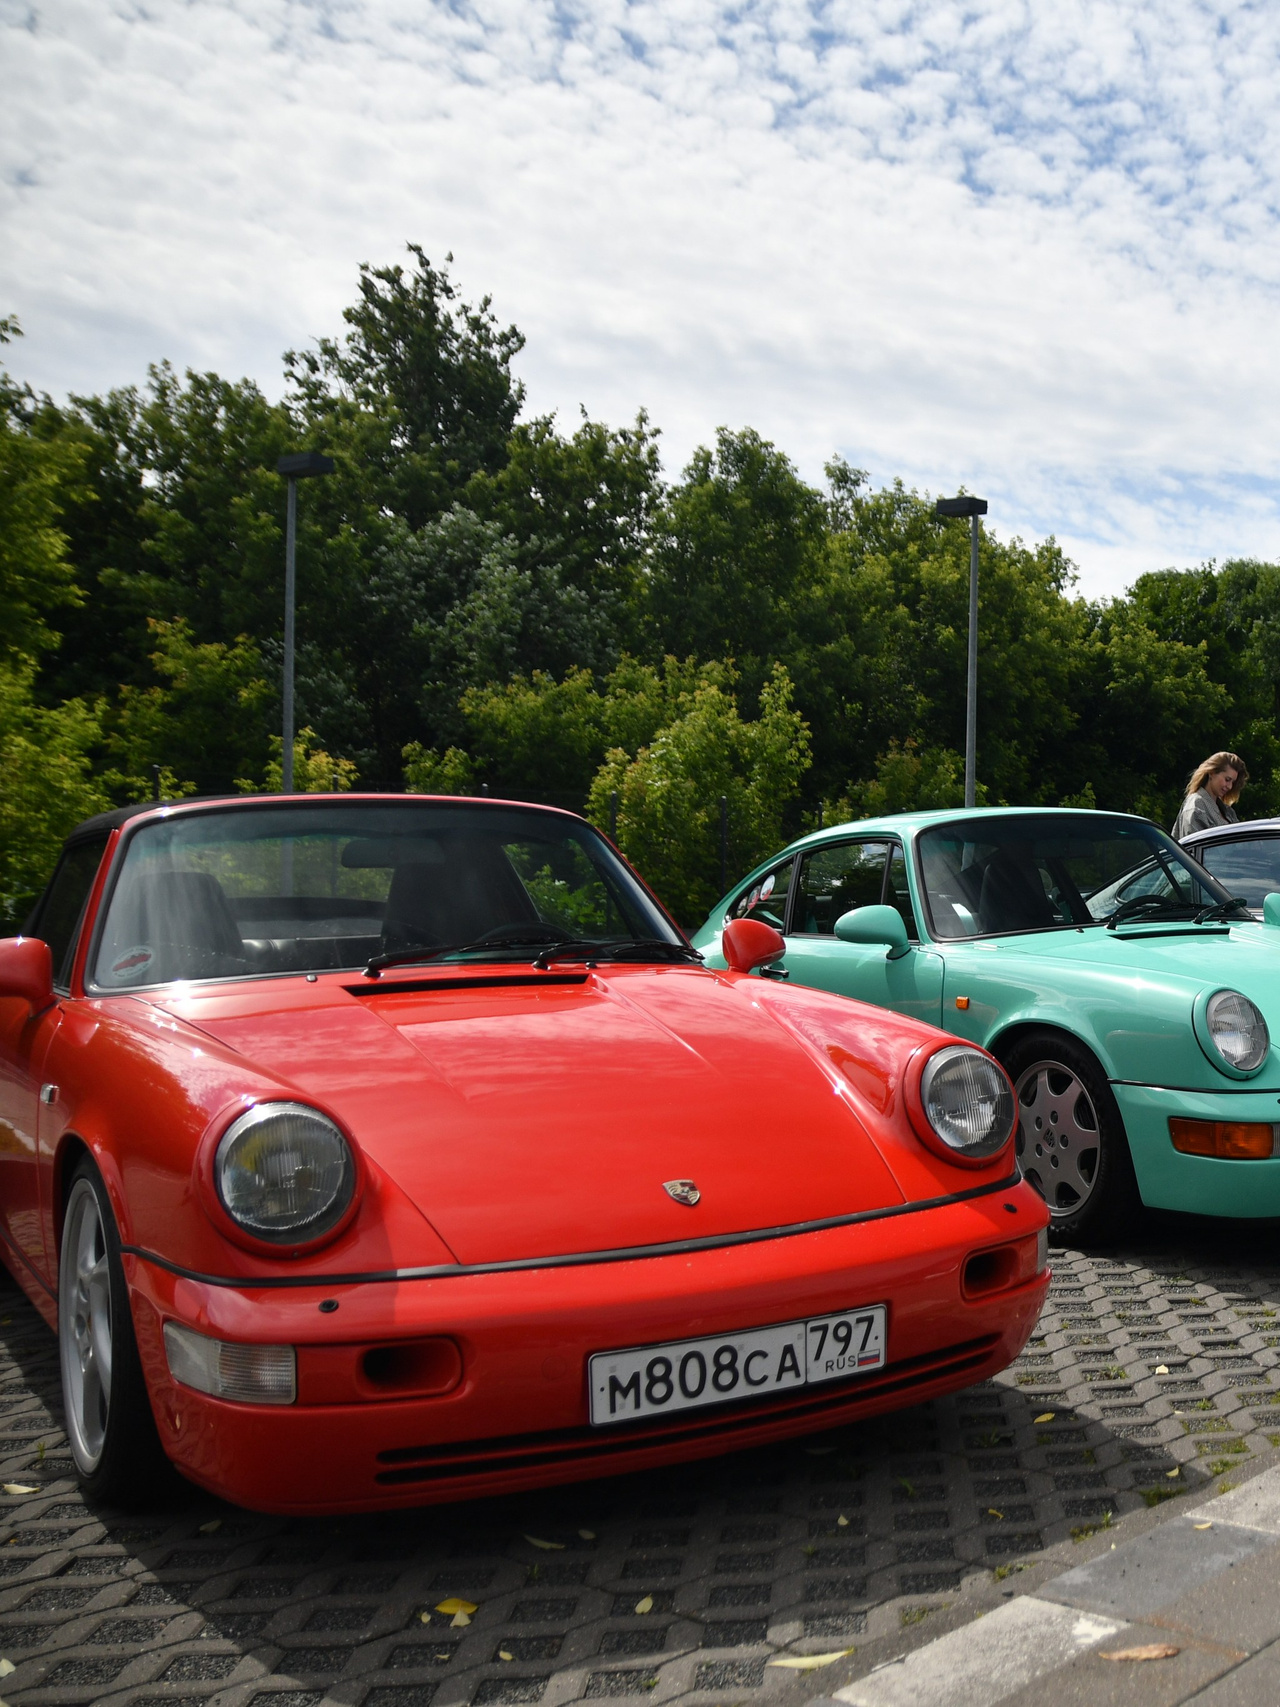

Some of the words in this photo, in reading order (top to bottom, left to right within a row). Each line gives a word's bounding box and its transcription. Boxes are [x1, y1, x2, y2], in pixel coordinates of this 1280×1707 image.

[608, 1344, 802, 1414] M808CA
[809, 1315, 875, 1361] 797
[825, 1355, 857, 1373] RUS
